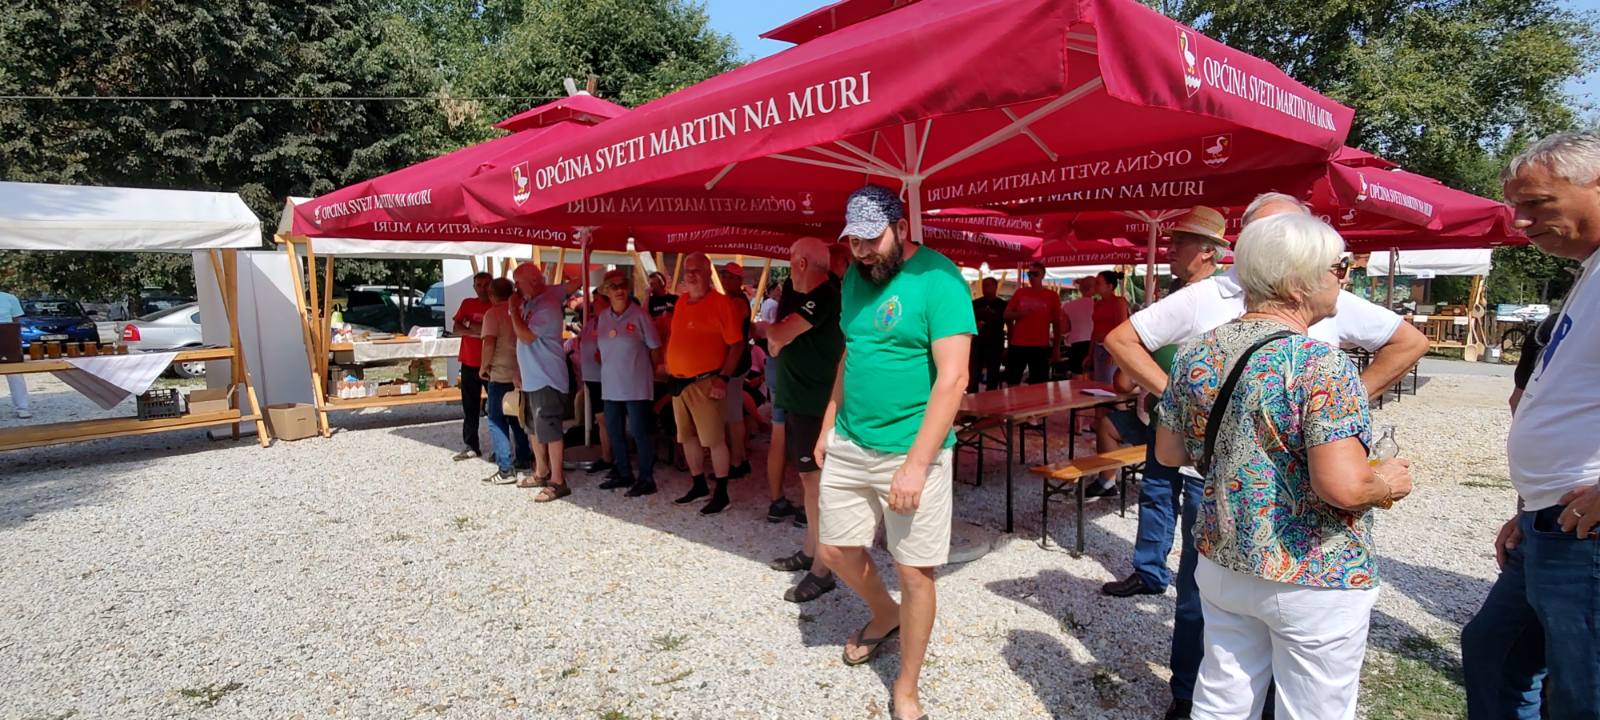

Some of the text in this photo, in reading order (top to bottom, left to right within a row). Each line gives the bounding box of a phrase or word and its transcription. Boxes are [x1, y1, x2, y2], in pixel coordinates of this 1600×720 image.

[1203, 56, 1247, 99] OPĆINA
[1249, 75, 1275, 109] SVETI
[1276, 87, 1306, 121] MARTIN
[1307, 103, 1316, 125] NA
[536, 71, 871, 190] OPĆINA SVETI MARTIN NA MURI
[349, 196, 372, 214] SVETI
[407, 189, 432, 207] MURI
[1120, 184, 1144, 199] NA
[1151, 180, 1205, 197] MURI
